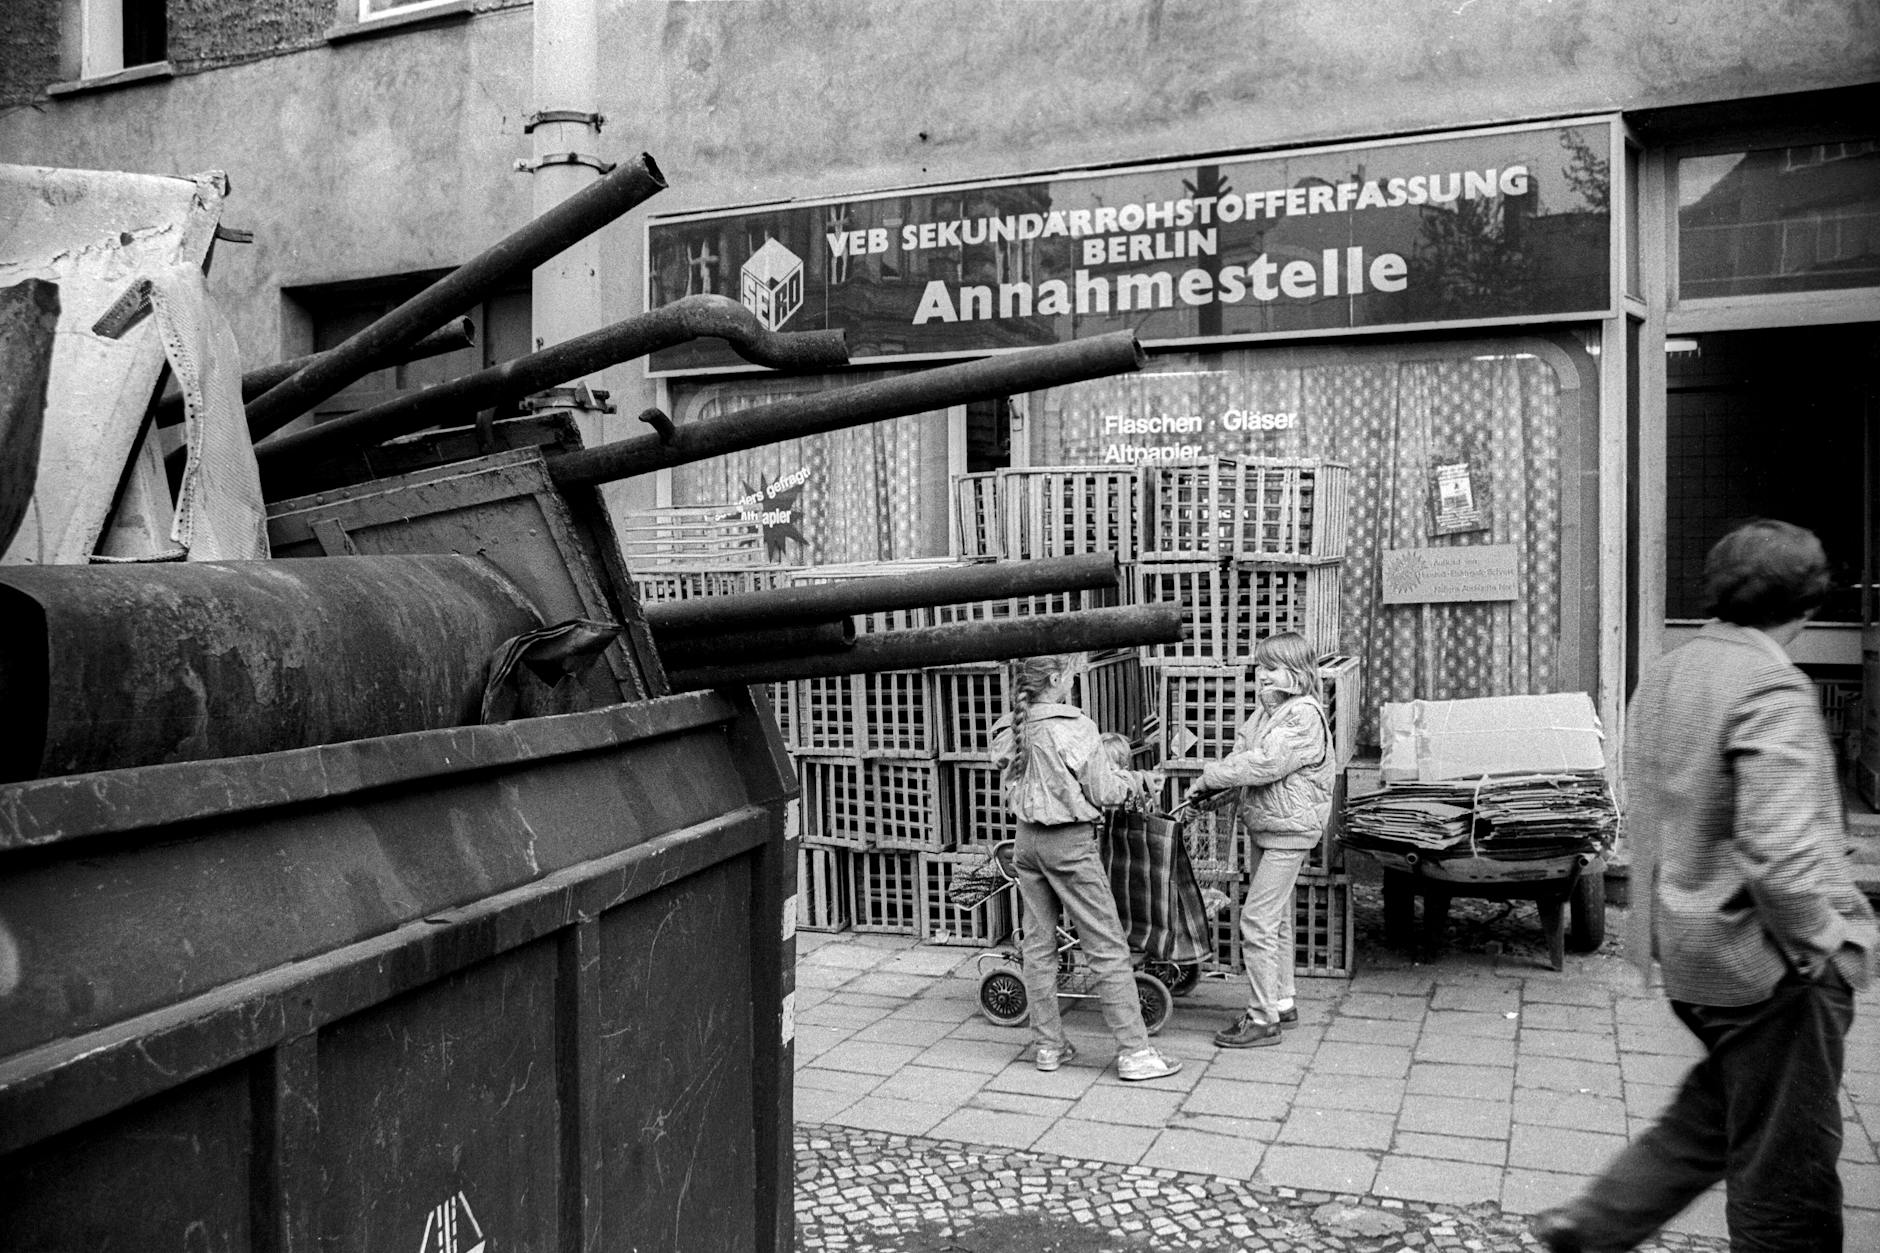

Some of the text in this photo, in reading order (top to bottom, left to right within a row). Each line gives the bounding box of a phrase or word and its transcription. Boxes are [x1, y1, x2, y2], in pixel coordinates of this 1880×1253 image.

[826, 165, 1528, 257] VEB SEKUNDÄRROHSTOFFERFASSUNG
[1083, 228, 1217, 265] BERLIN
[743, 270, 801, 329] SERO
[912, 246, 1408, 325] Annahmestelle
[1105, 409, 1297, 435] Flaschen Gläser
